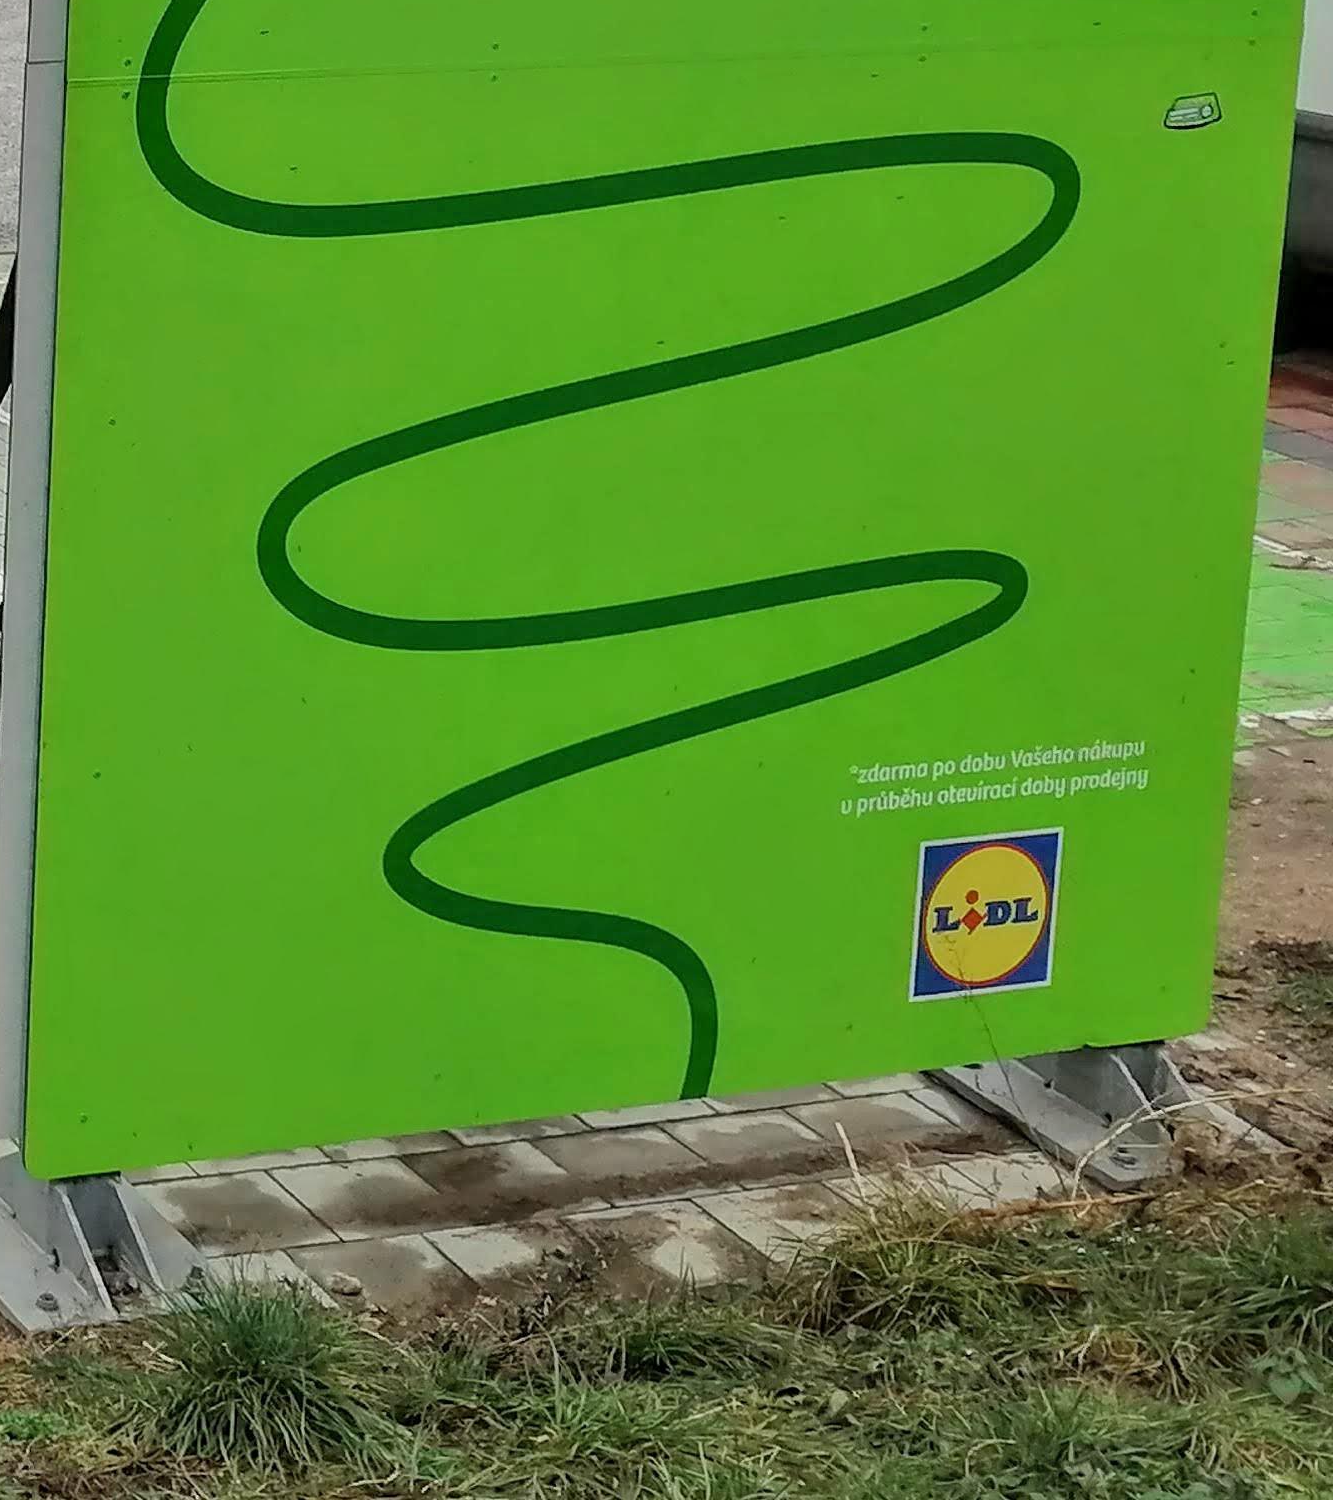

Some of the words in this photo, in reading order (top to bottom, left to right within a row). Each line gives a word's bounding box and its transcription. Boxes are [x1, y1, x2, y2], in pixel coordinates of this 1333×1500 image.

[932, 759, 956, 781] po
[959, 753, 1007, 775] dobu
[1011, 746, 1075, 769] Vašeho
[1078, 739, 1146, 764] nákupu
[841, 799, 852, 815] v
[856, 787, 934, 818] průběhu
[937, 776, 1018, 806] otevírací
[1021, 774, 1066, 799] doby
[1070, 767, 1149, 796] prodejny
[931, 888, 1039, 936] LIDL
